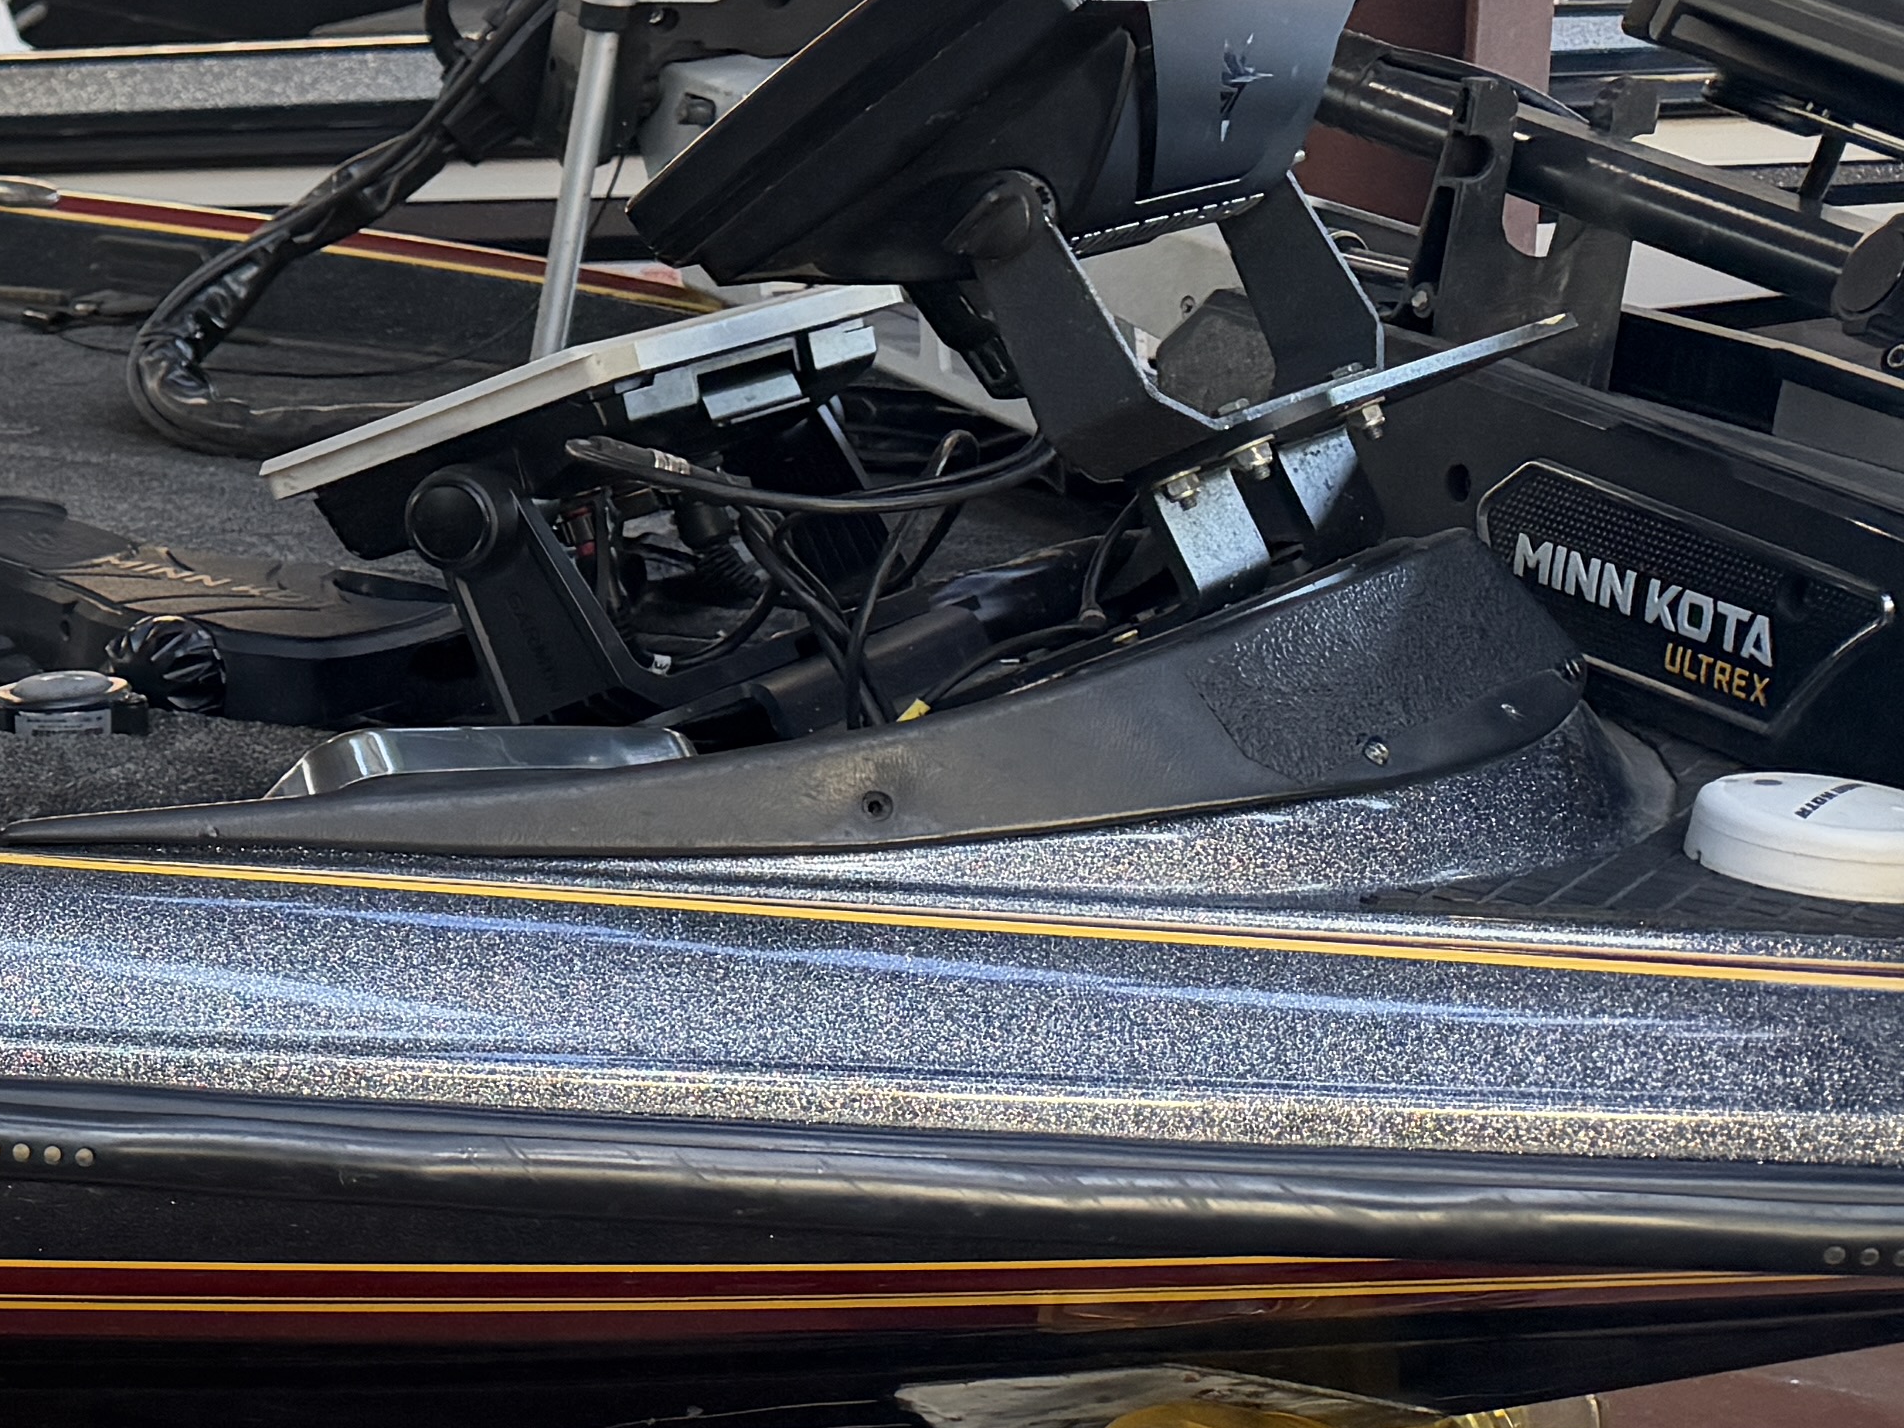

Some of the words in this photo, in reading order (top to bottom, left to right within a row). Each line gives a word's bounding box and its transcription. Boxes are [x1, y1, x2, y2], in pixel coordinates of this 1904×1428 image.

[1511, 532, 1638, 616] MINN
[1644, 577, 1774, 667] KOTA
[1664, 642, 1770, 708] ULTREX
